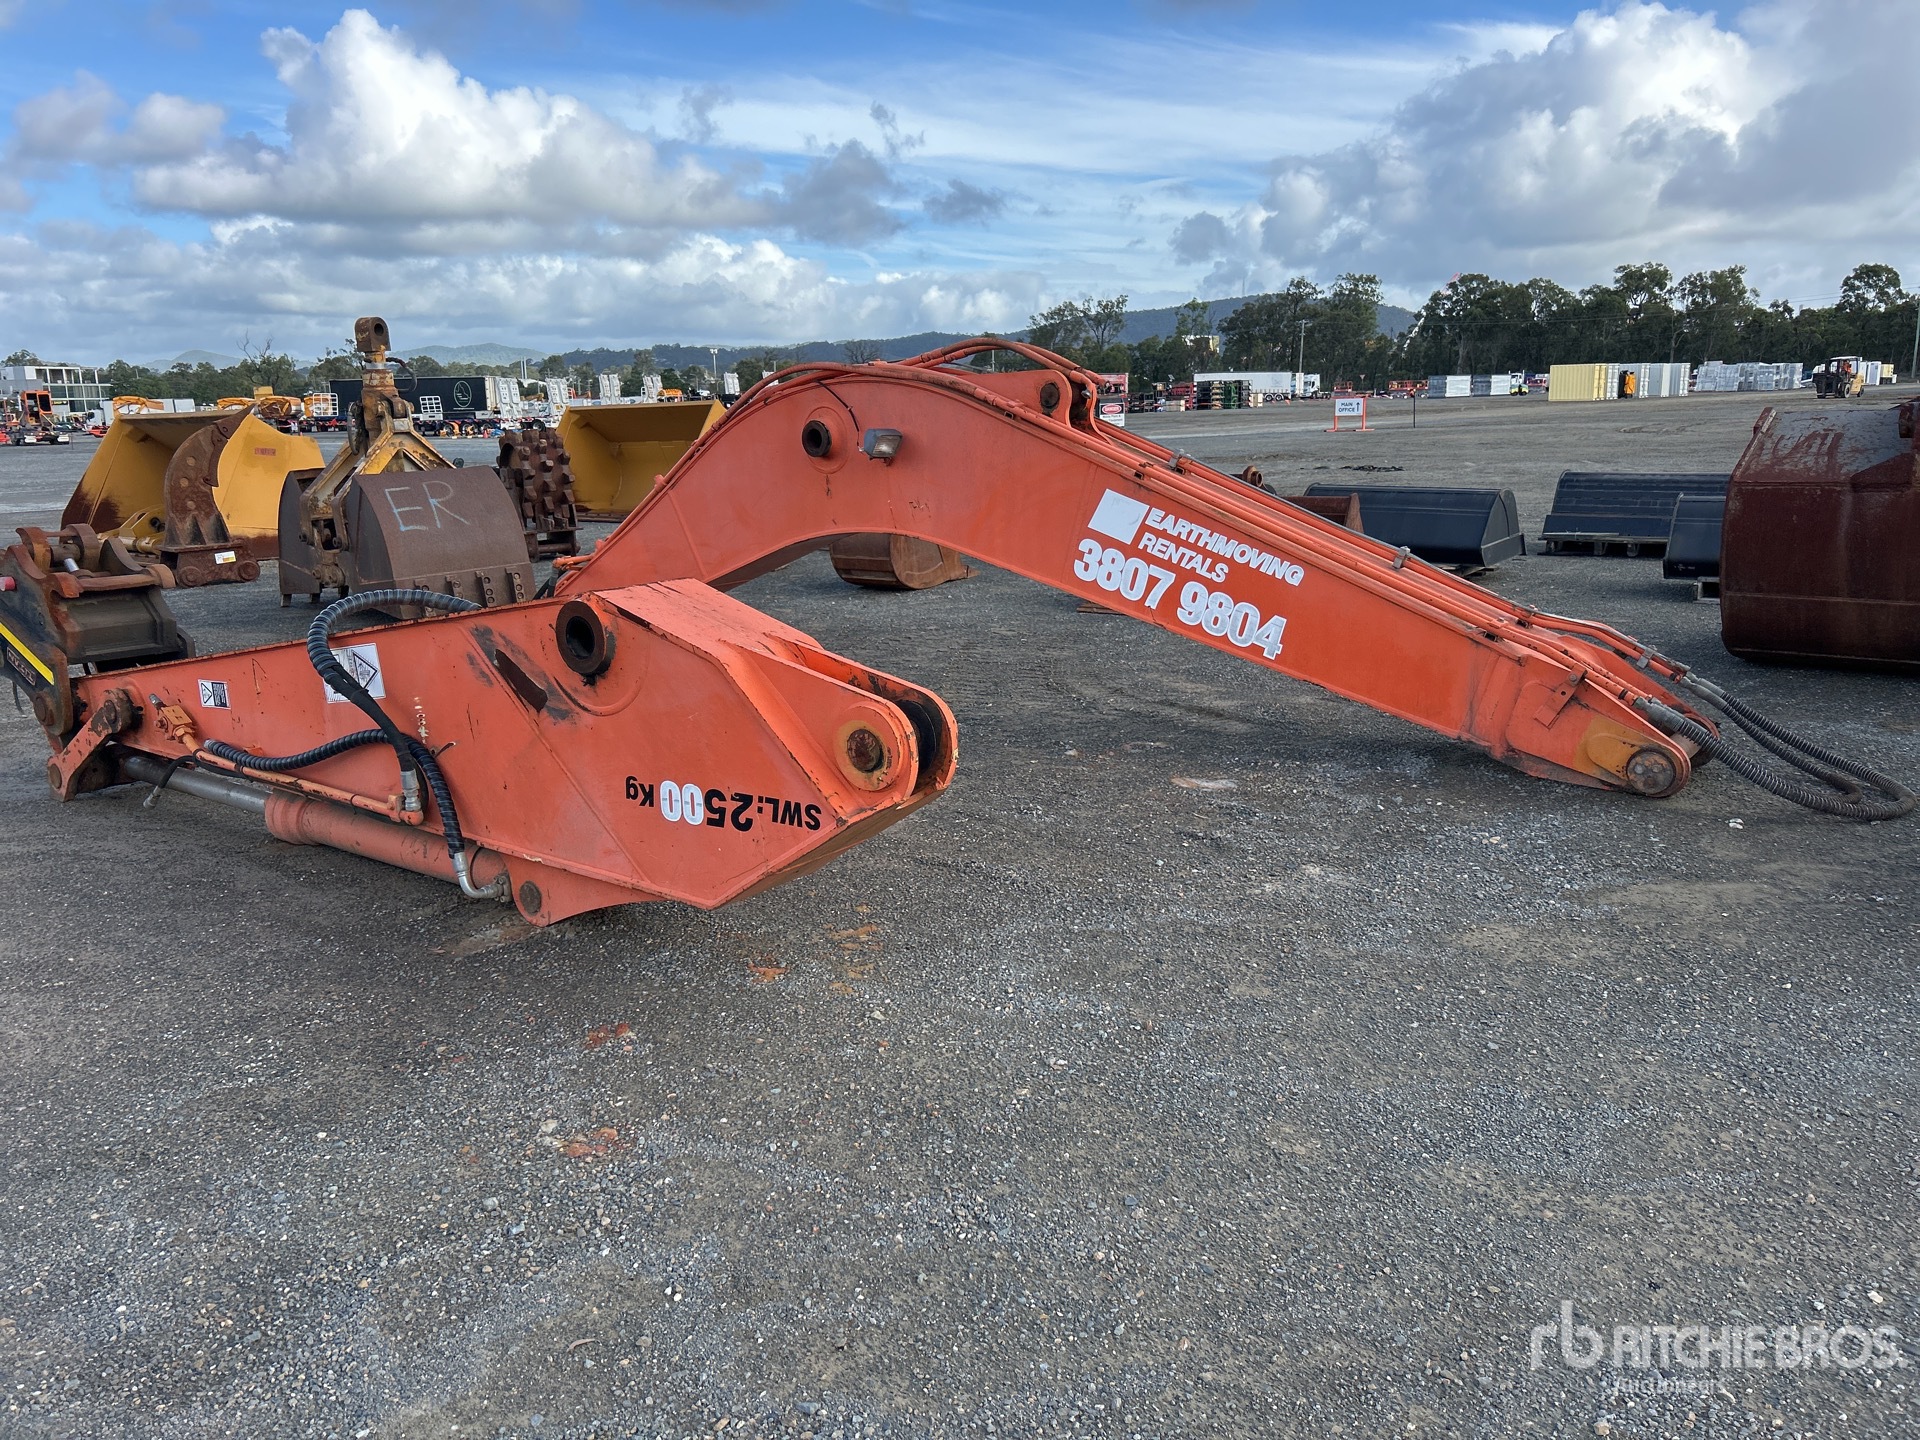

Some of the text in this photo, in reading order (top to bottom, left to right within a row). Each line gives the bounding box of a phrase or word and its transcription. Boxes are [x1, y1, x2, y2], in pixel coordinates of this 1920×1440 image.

[383, 480, 470, 532] ER
[1137, 532, 1229, 583] RENTALS
[1144, 507, 1305, 586] EARTHMOVING
[1073, 539, 1288, 660] 3807 9804
